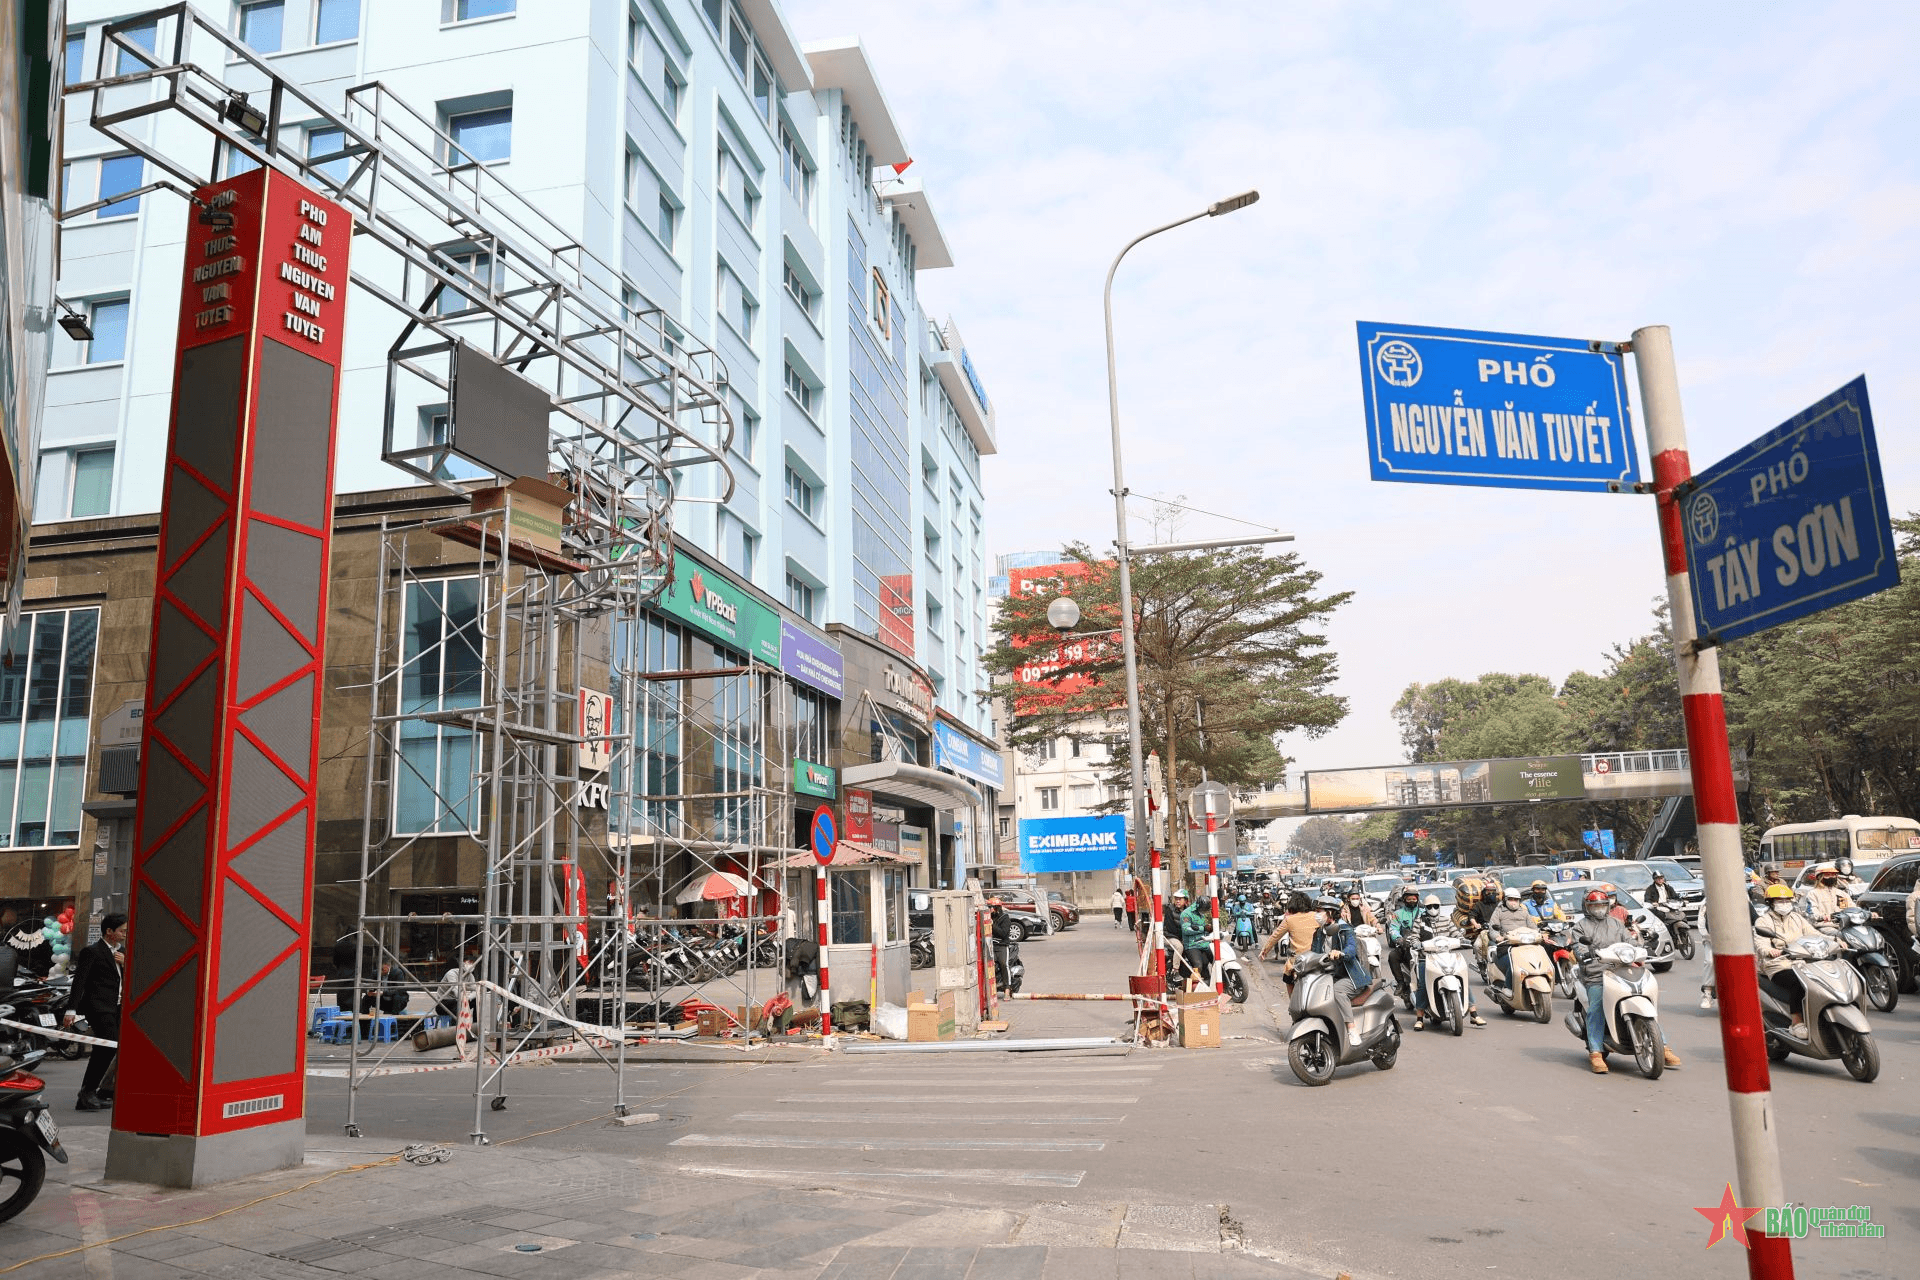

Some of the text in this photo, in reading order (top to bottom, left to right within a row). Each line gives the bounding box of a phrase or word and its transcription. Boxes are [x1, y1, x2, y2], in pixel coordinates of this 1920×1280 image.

[300, 200, 328, 226] PHO
[300, 223, 323, 247] AM
[192, 256, 246, 283] NGUYEN
[294, 242, 328, 272] THUC
[203, 282, 232, 303] VAN
[281, 262, 335, 301] NGUYEN
[194, 305, 236, 328] TUYET
[294, 291, 321, 318] VAN
[285, 311, 326, 344] TUYET
[1477, 353, 1556, 388] PHỐ
[1389, 388, 1613, 465] NGUYỄN VĂN TUYẾT
[1750, 432, 1809, 505] PHỐ
[1706, 496, 1860, 612] TÂY SƠN
[705, 587, 738, 625] VPBank
[1533, 771, 1558, 780] essence
[1535, 778, 1551, 788] life
[1029, 832, 1117, 848] EXIMBANK
